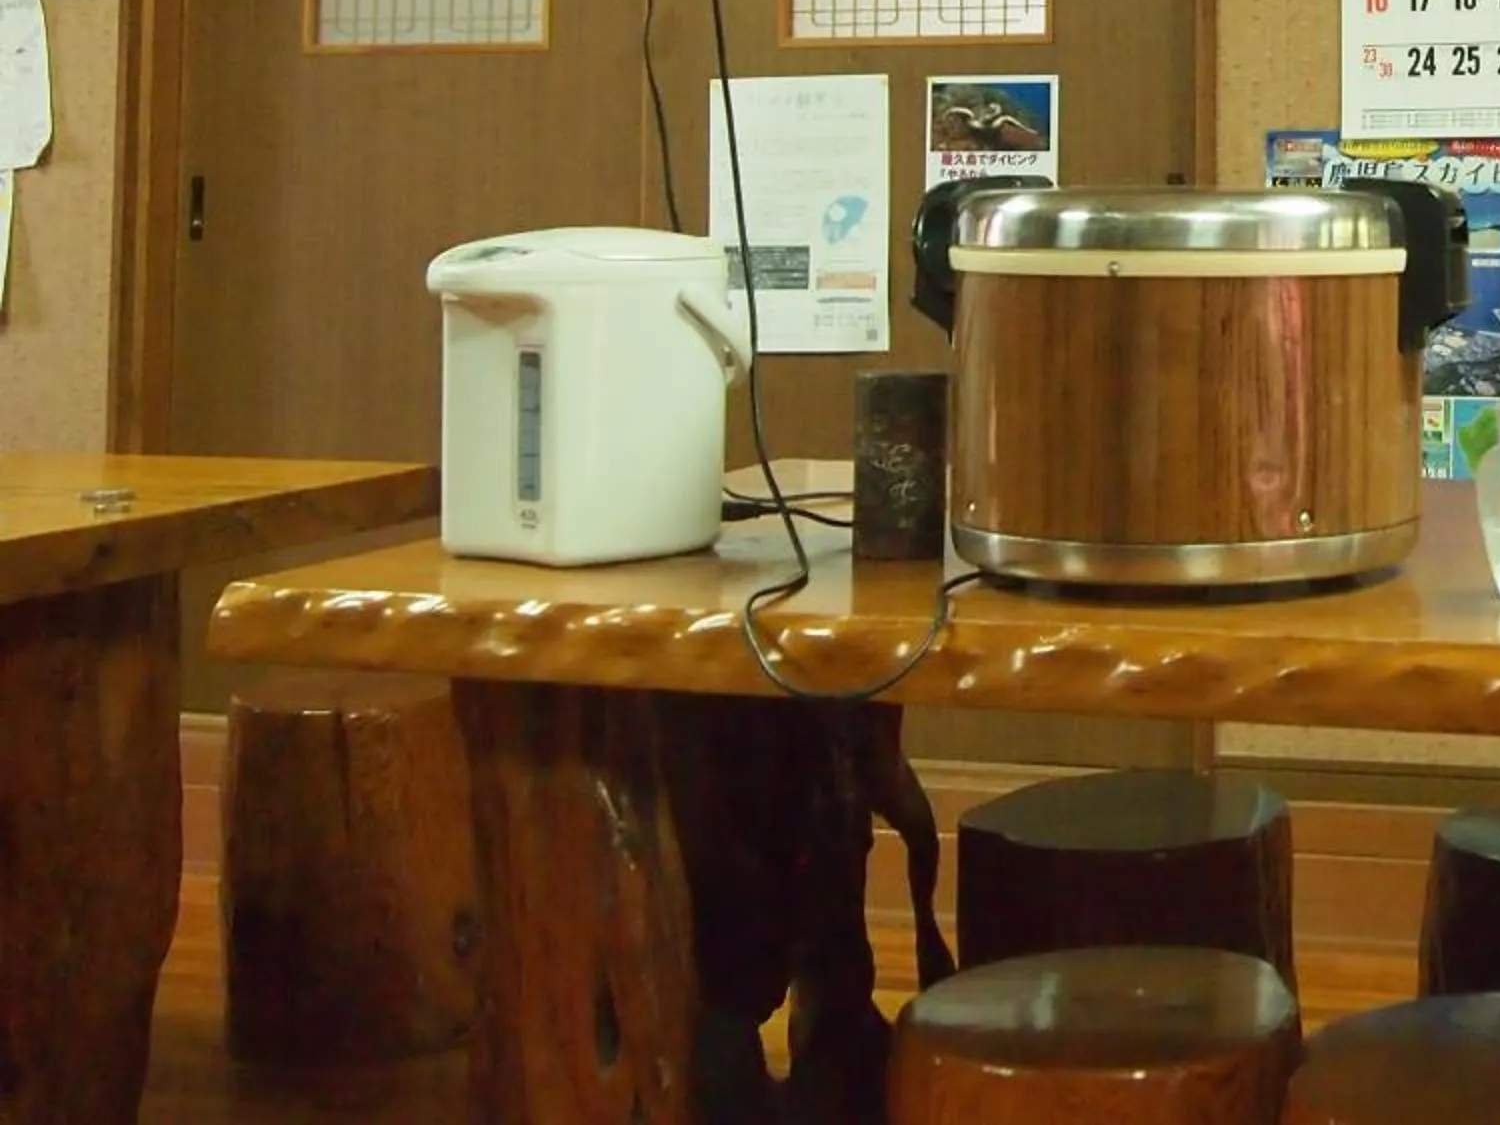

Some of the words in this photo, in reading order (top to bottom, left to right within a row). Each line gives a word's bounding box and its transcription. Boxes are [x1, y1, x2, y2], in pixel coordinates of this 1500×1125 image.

[1363, 48, 1377, 63] 23
[1408, 47, 1436, 77] 24
[1452, 46, 1480, 75] 25
